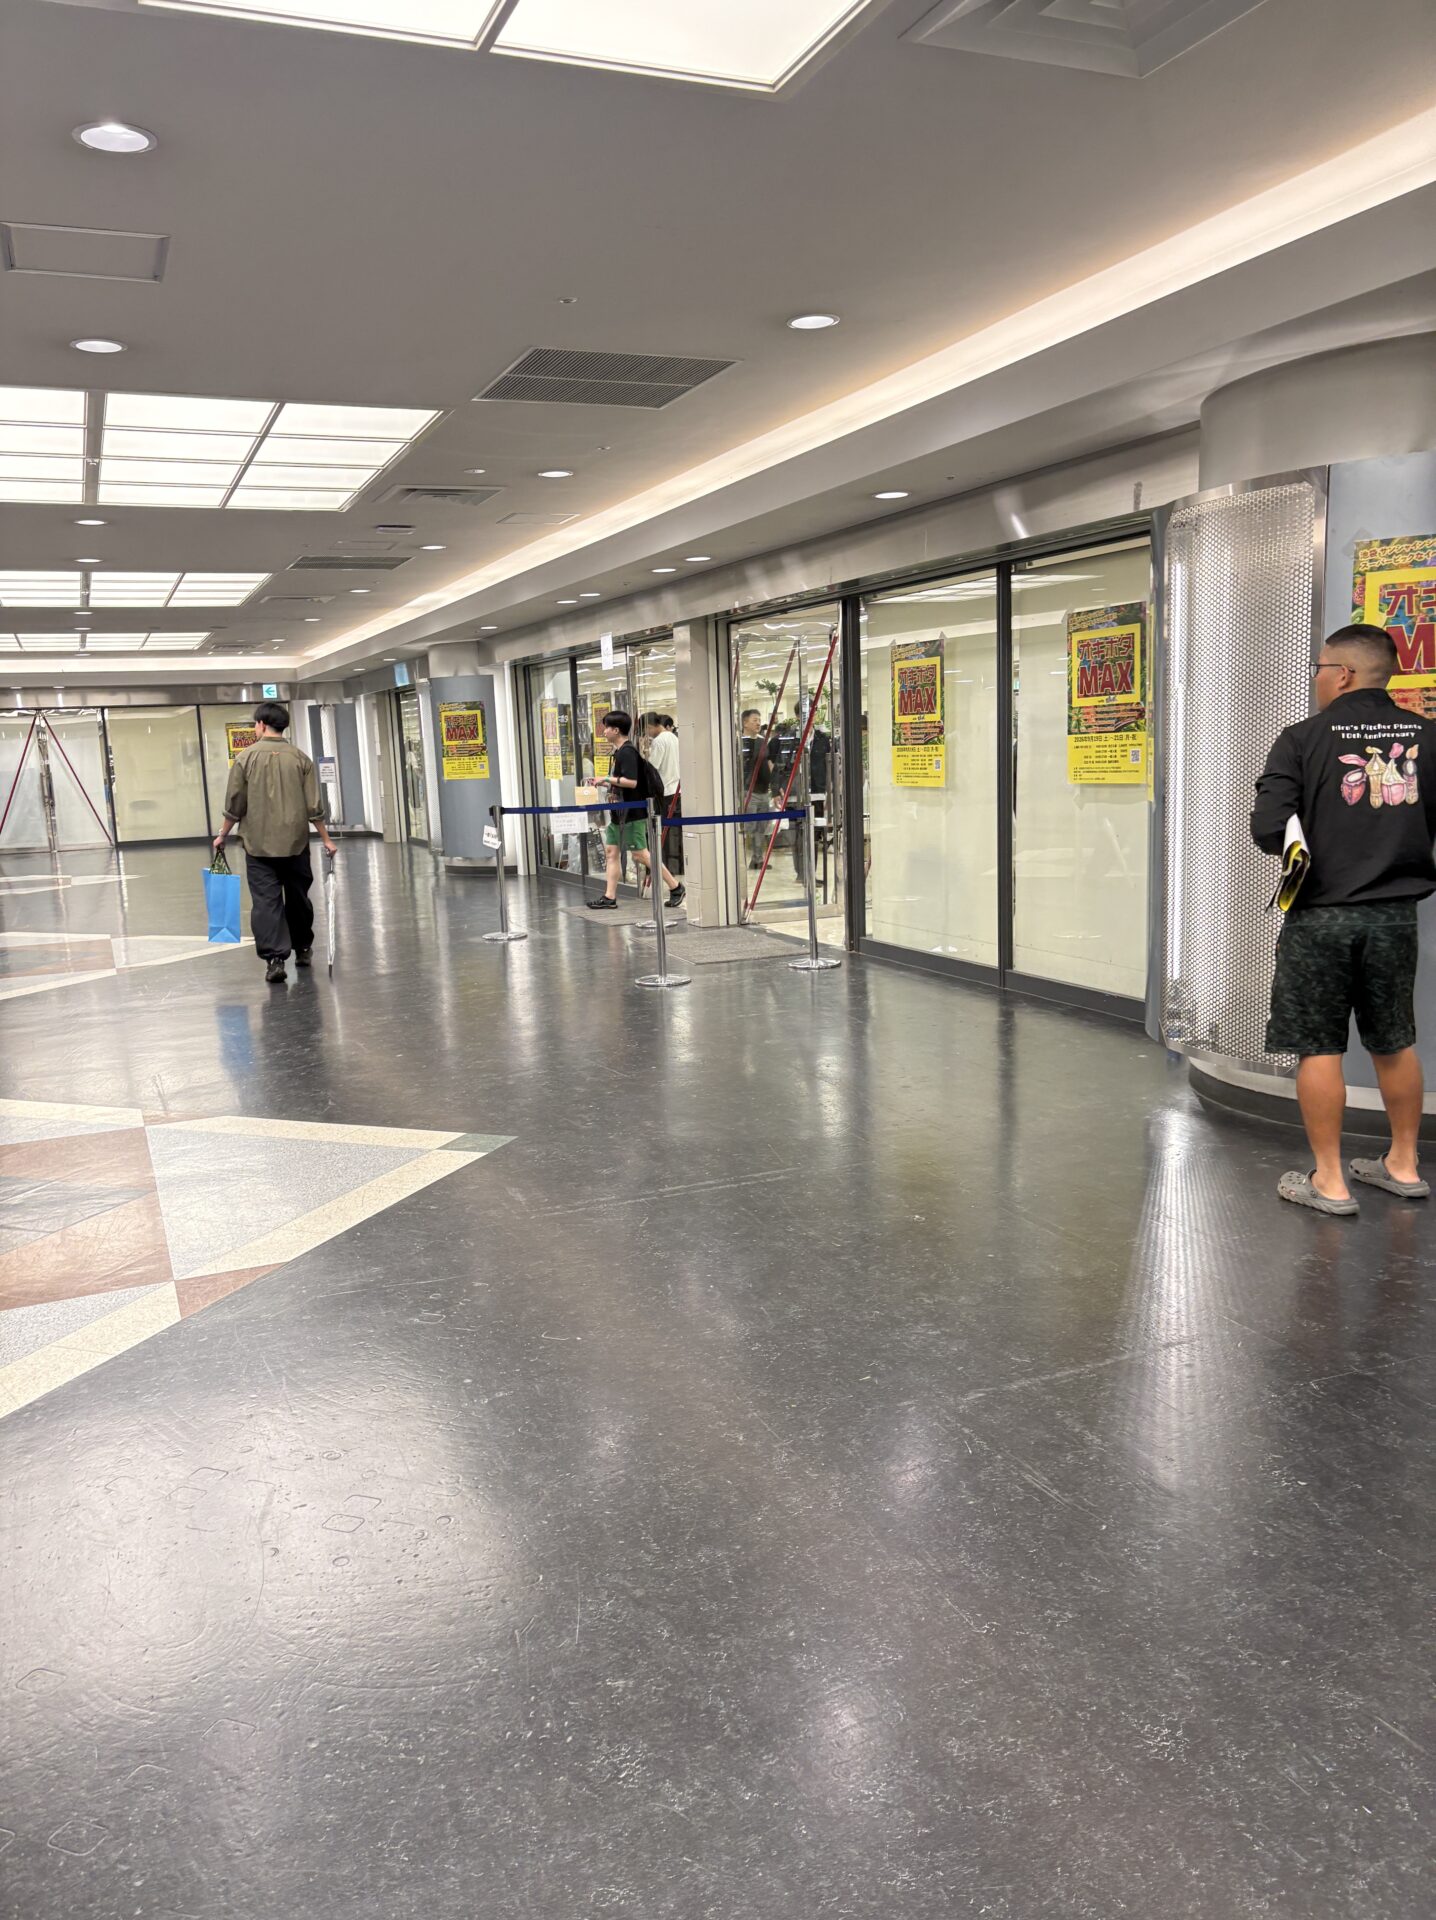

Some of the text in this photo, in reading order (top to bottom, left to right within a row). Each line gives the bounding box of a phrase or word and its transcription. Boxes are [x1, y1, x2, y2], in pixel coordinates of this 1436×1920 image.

[1079, 634, 1133, 660] オキボタ
[1079, 660, 1133, 696] MAX
[899, 687, 936, 714] MAX
[446, 726, 478, 740] MAX
[1331, 723, 1359, 732] Hiro's
[1360, 723, 1391, 731] Pitcher
[1363, 731, 1416, 740] Anniversary
